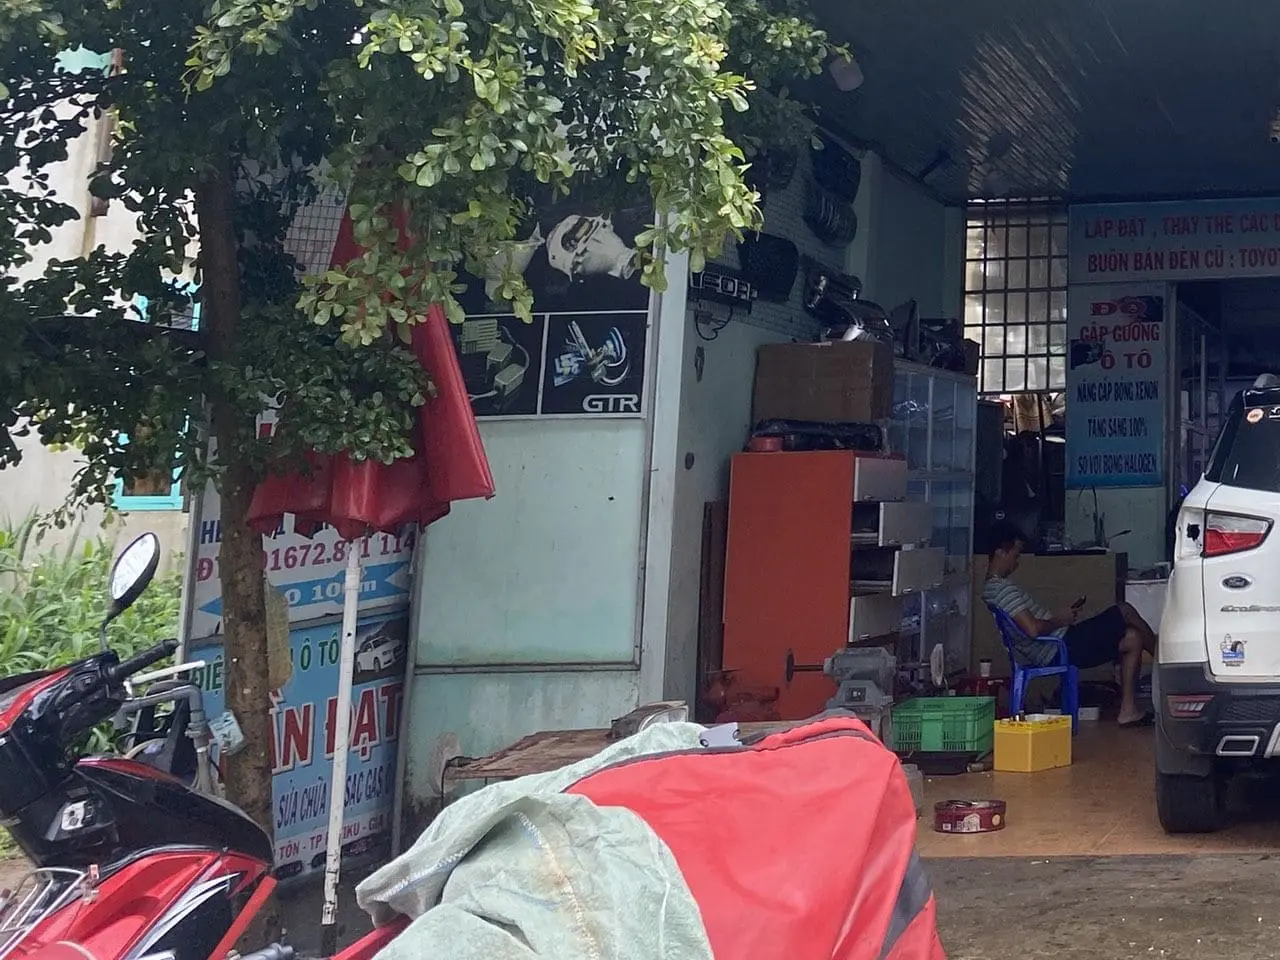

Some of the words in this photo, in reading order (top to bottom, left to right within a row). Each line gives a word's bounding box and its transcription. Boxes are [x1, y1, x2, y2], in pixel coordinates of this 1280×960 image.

[1162, 215, 1200, 235] THAY
[1123, 348, 1152, 369] TÔ
[583, 394, 640, 413] GTR
